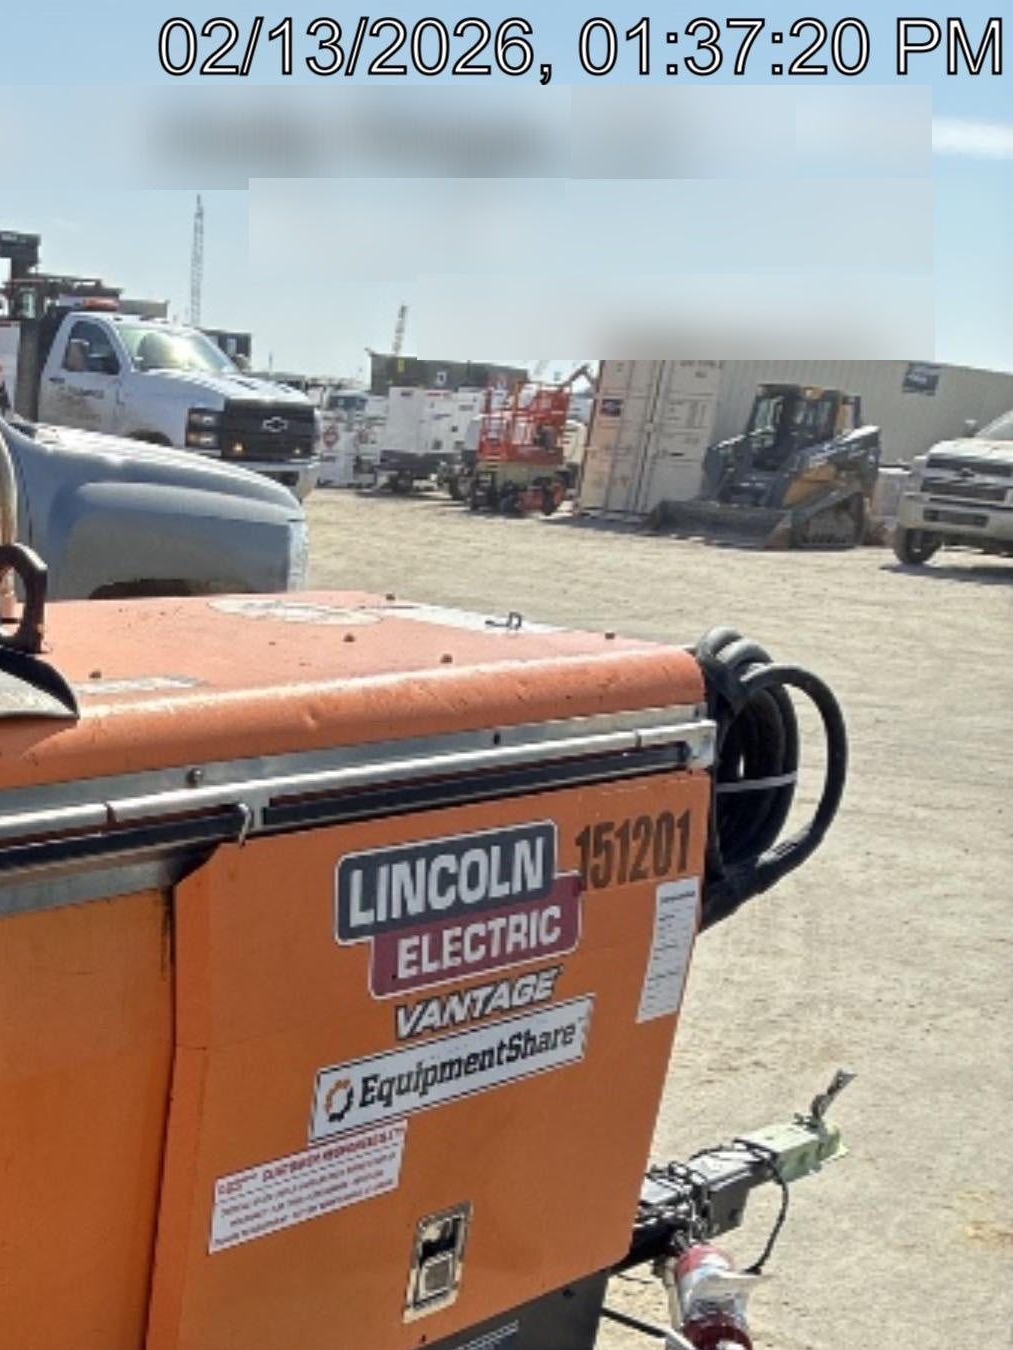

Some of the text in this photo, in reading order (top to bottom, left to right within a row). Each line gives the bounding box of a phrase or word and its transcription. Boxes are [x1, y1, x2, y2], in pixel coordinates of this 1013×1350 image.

[349, 836, 545, 928] LINCOLN
[575, 808, 692, 890] 151201
[396, 905, 562, 980] ELECTRIC
[396, 967, 559, 1040] VANTAGE
[358, 1022, 577, 1108] EquipmentShare
